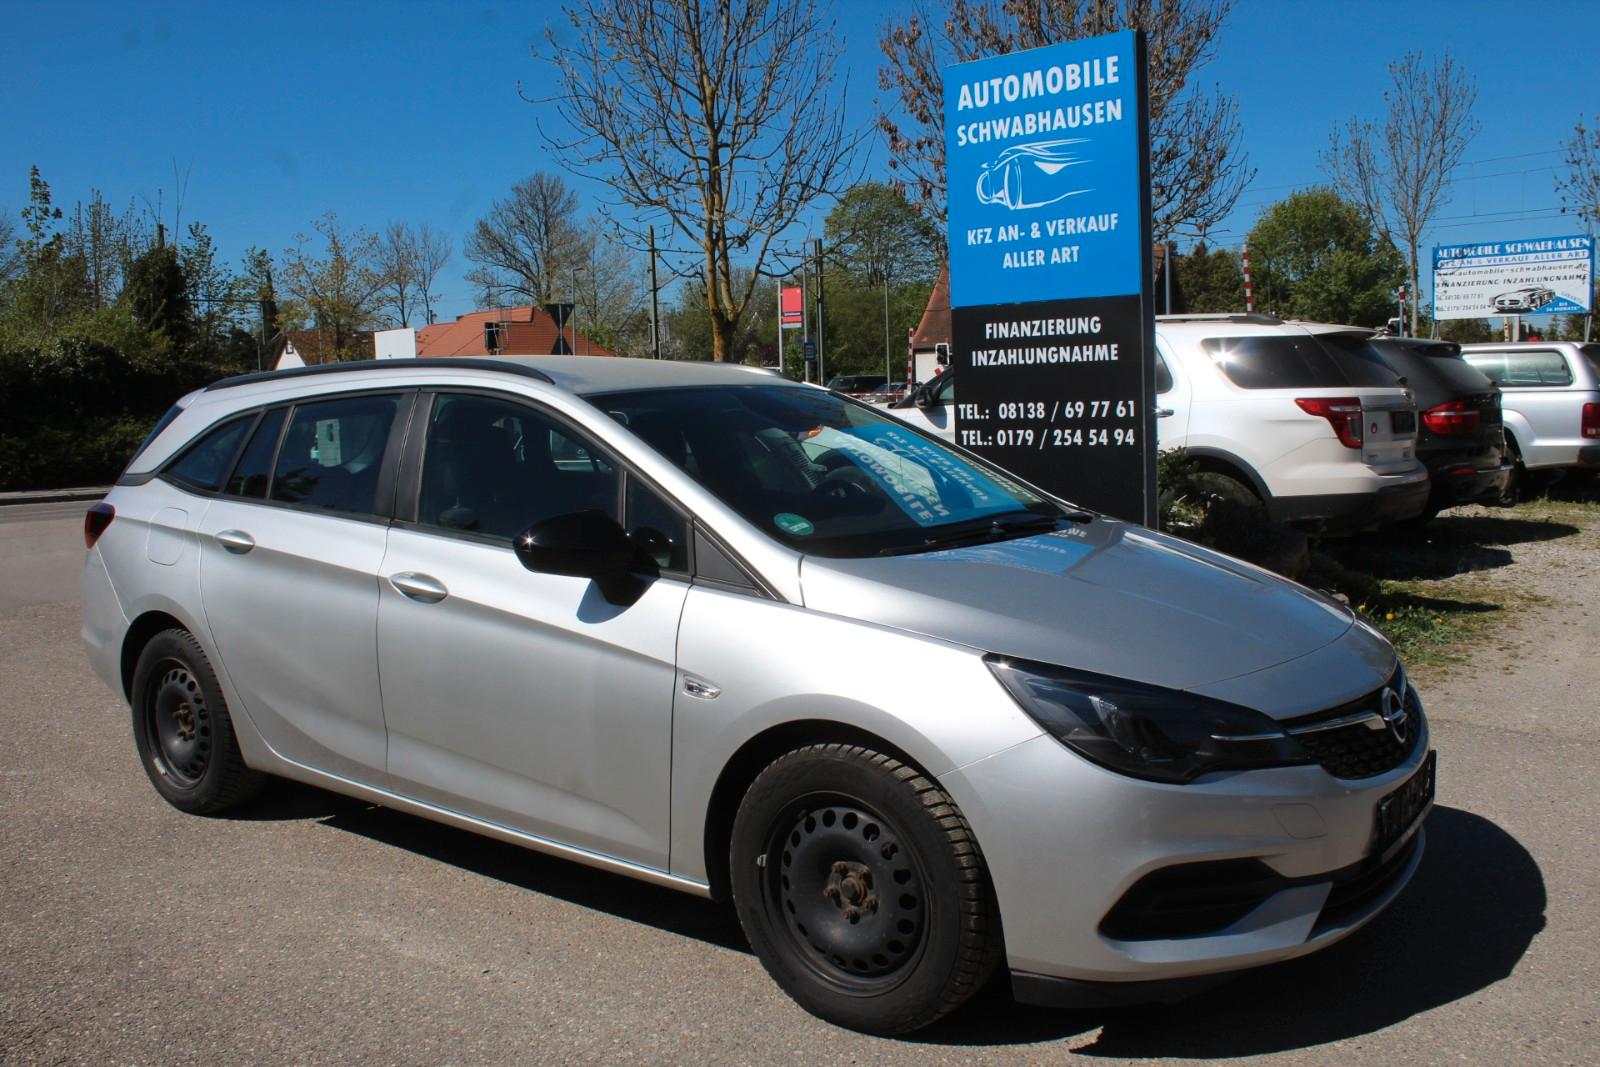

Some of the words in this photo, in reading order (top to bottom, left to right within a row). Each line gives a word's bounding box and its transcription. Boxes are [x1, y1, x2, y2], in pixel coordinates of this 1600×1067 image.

[957, 55, 1120, 111] AUTOMOBILE
[957, 98, 1123, 147] SCHWABHAUSEN
[967, 227, 993, 246] KFZ
[997, 224, 1026, 242] AN-
[1030, 221, 1041, 239] &
[1046, 213, 1119, 237] VERKAUF
[1002, 247, 1045, 269] ALLER
[1050, 245, 1080, 264] ART
[1487, 255, 1529, 264] VERKAUF
[1534, 252, 1563, 260] ALLER
[1568, 250, 1587, 258] ART
[985, 316, 1102, 340] FINANZIERUNG
[972, 343, 1119, 367] INZAHLUNGNAHME
[958, 403, 990, 420] TEL.:
[998, 402, 1046, 420] 08138
[1051, 401, 1059, 423] /
[1064, 401, 1085, 419] 69
[1090, 400, 1110, 418] 77
[1116, 400, 1136, 418] 61
[961, 430, 993, 446] TEL.:
[996, 429, 1034, 446] 0179
[1039, 428, 1048, 450] /
[1053, 429, 1083, 446] 254
[1088, 429, 1109, 446] 54
[1114, 429, 1135, 446] 94
